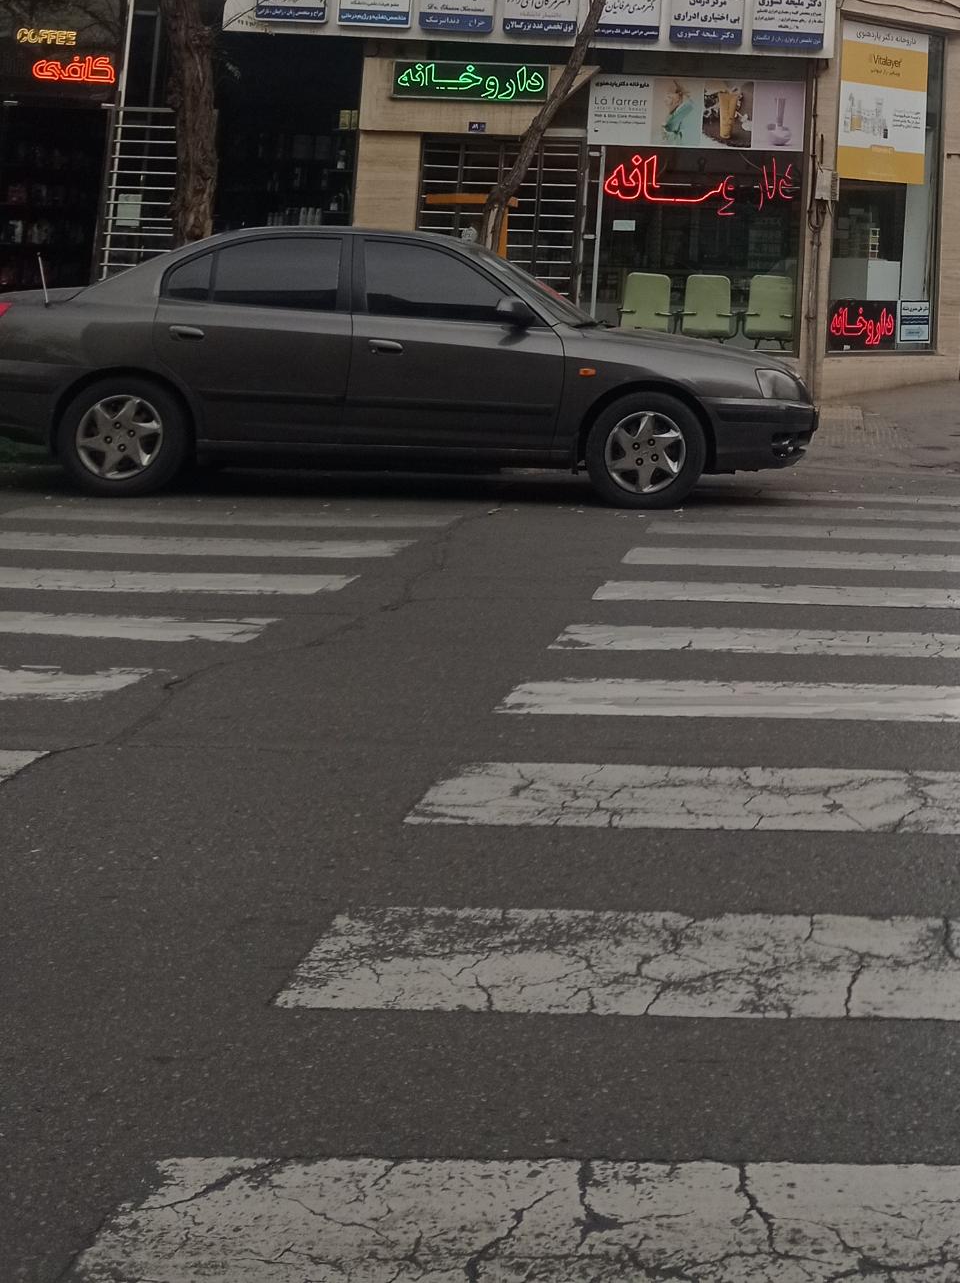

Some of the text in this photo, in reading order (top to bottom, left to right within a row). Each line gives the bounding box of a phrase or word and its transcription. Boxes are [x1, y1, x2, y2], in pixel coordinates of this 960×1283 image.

[628, 3, 646, 14] مهدی
[673, 11, 741, 24] بی اختیاری ادراری
[17, 27, 77, 46] COFFEE
[720, 31, 735, 41] دکتر
[33, 56, 115, 83] کافی
[873, 53, 903, 69] Vitalayer
[397, 63, 545, 100] داروخانه
[830, 307, 894, 345] داروخانه
